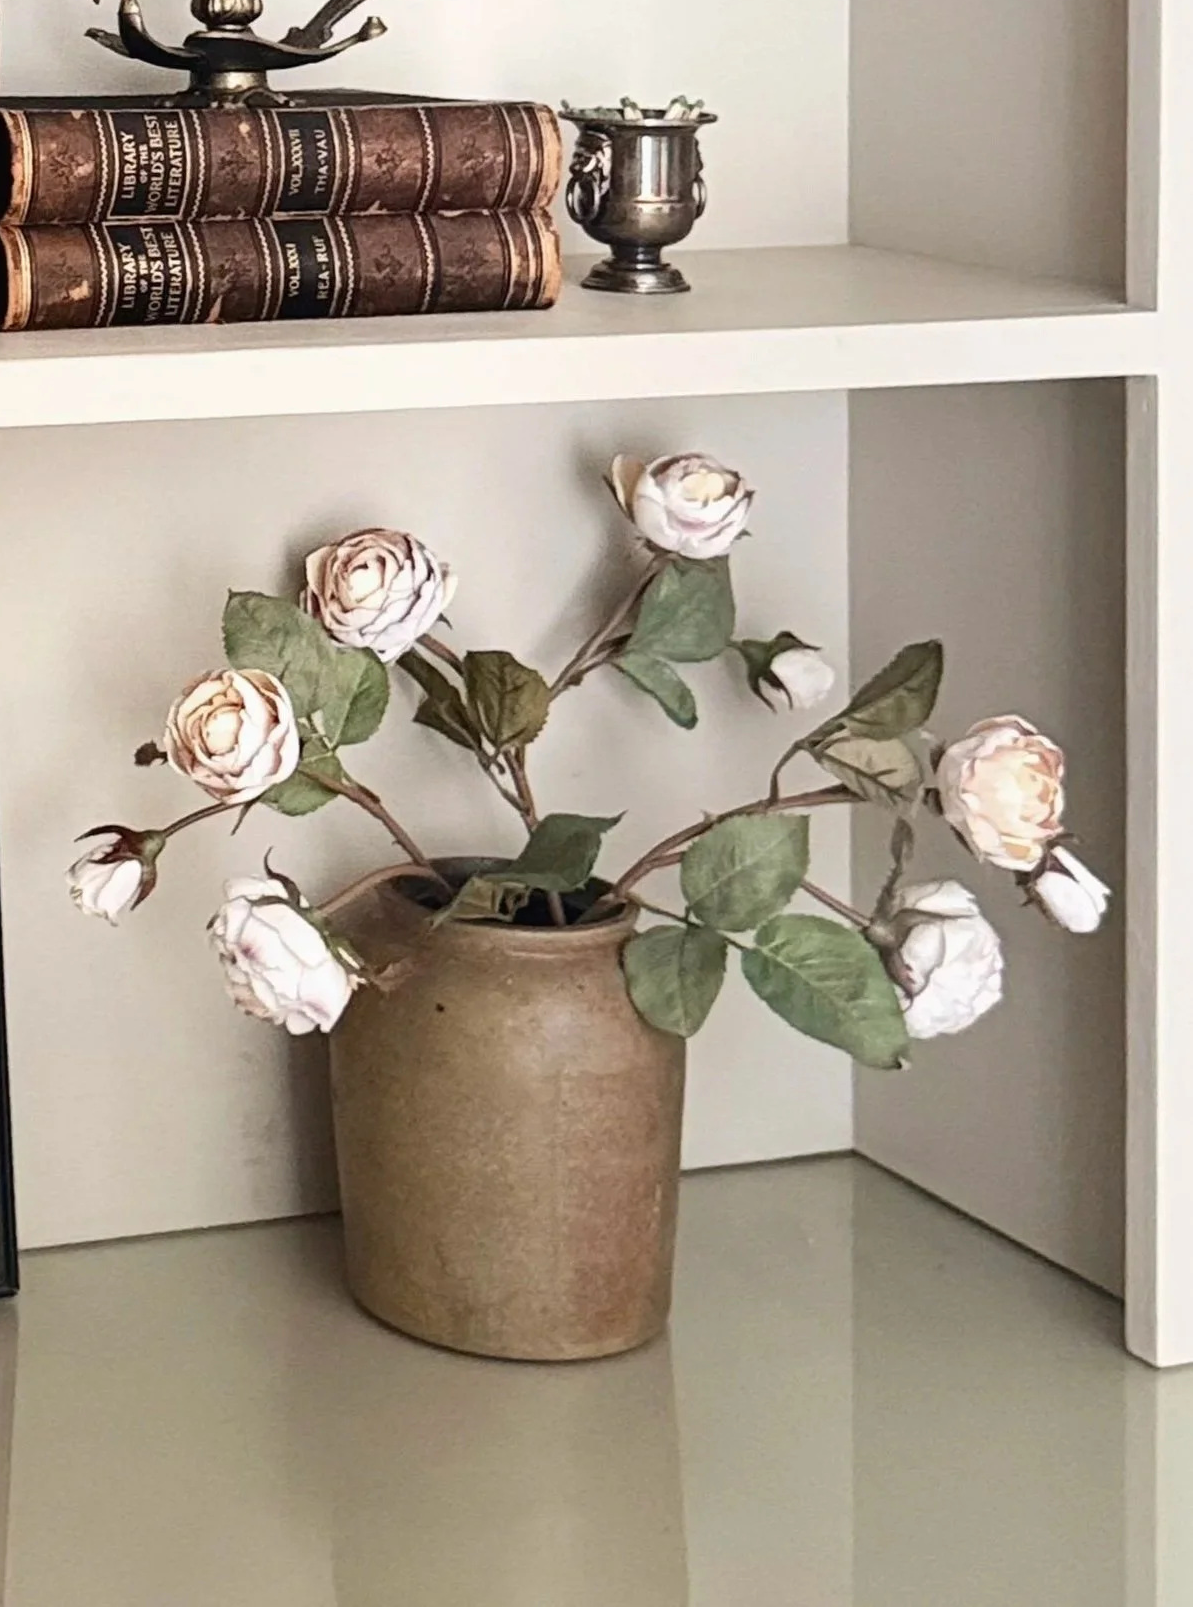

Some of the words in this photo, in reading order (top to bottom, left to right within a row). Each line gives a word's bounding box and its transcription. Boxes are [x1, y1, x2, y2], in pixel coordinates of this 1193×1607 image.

[139, 143, 148, 165] THE
[144, 114, 163, 148] BEST
[313, 129, 329, 194] THA-VAU
[119, 131, 137, 199] LIBRARY
[139, 169, 148, 184] OF
[144, 151, 165, 213] WORLD'S
[164, 120, 183, 207] LITERATURE
[138, 254, 149, 275] THE
[140, 226, 161, 258] BEST
[116, 242, 137, 309] LIBRARY
[140, 278, 148, 293] OF
[144, 260, 164, 322] WORLD'S
[160, 232, 182, 316] LITERATURE
